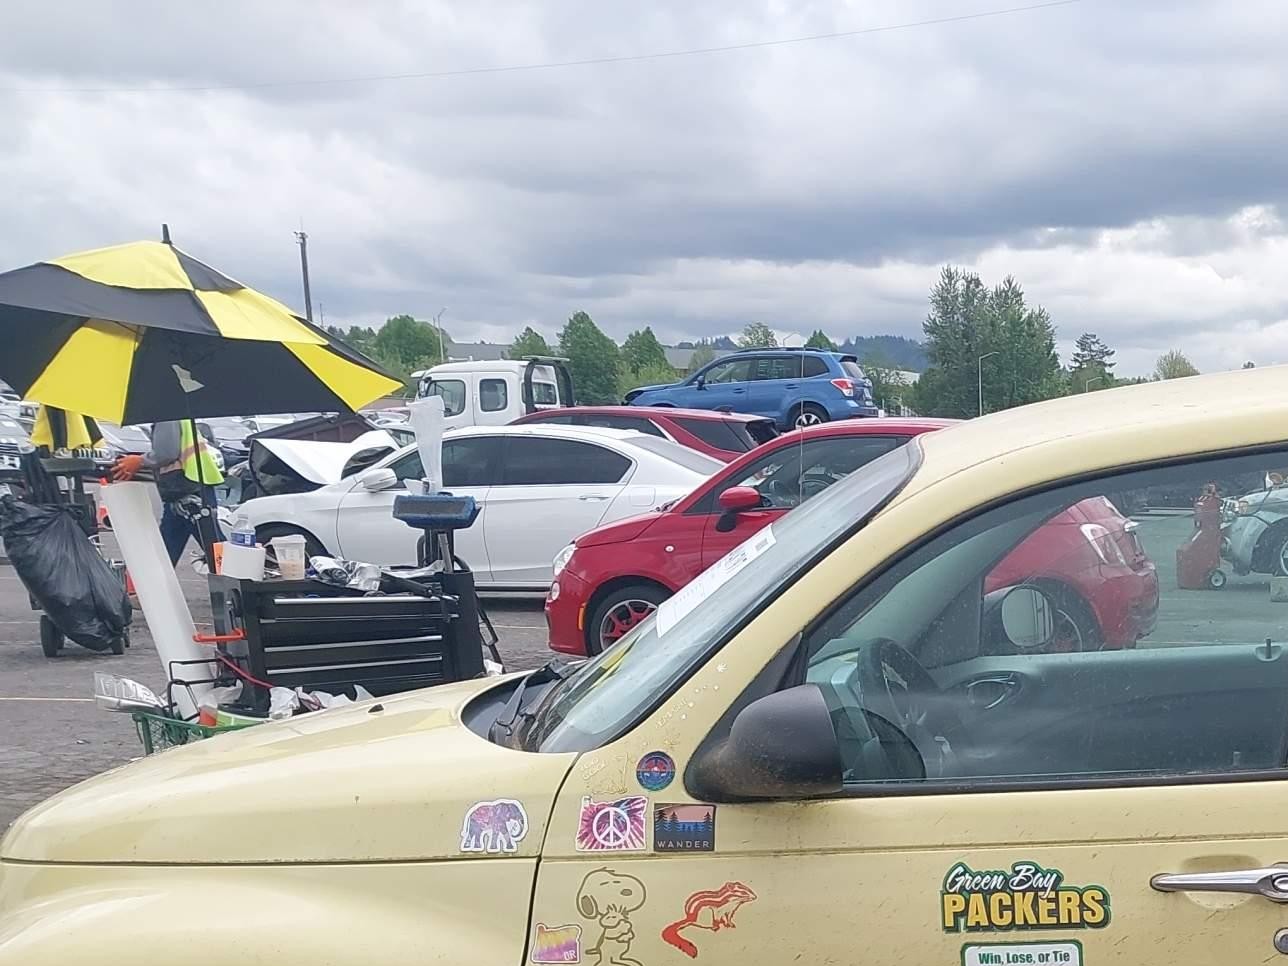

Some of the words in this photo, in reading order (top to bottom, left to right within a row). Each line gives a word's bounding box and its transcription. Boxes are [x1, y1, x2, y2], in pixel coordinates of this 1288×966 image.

[657, 840, 710, 848] WANDER
[946, 866, 1006, 894] Green
[1008, 864, 1058, 898] Bay
[943, 889, 1105, 927] PACKERS
[978, 952, 1004, 966] Win,
[1006, 951, 1036, 965] Lose,
[1037, 952, 1051, 964] or
[1052, 950, 1070, 962] Tie
